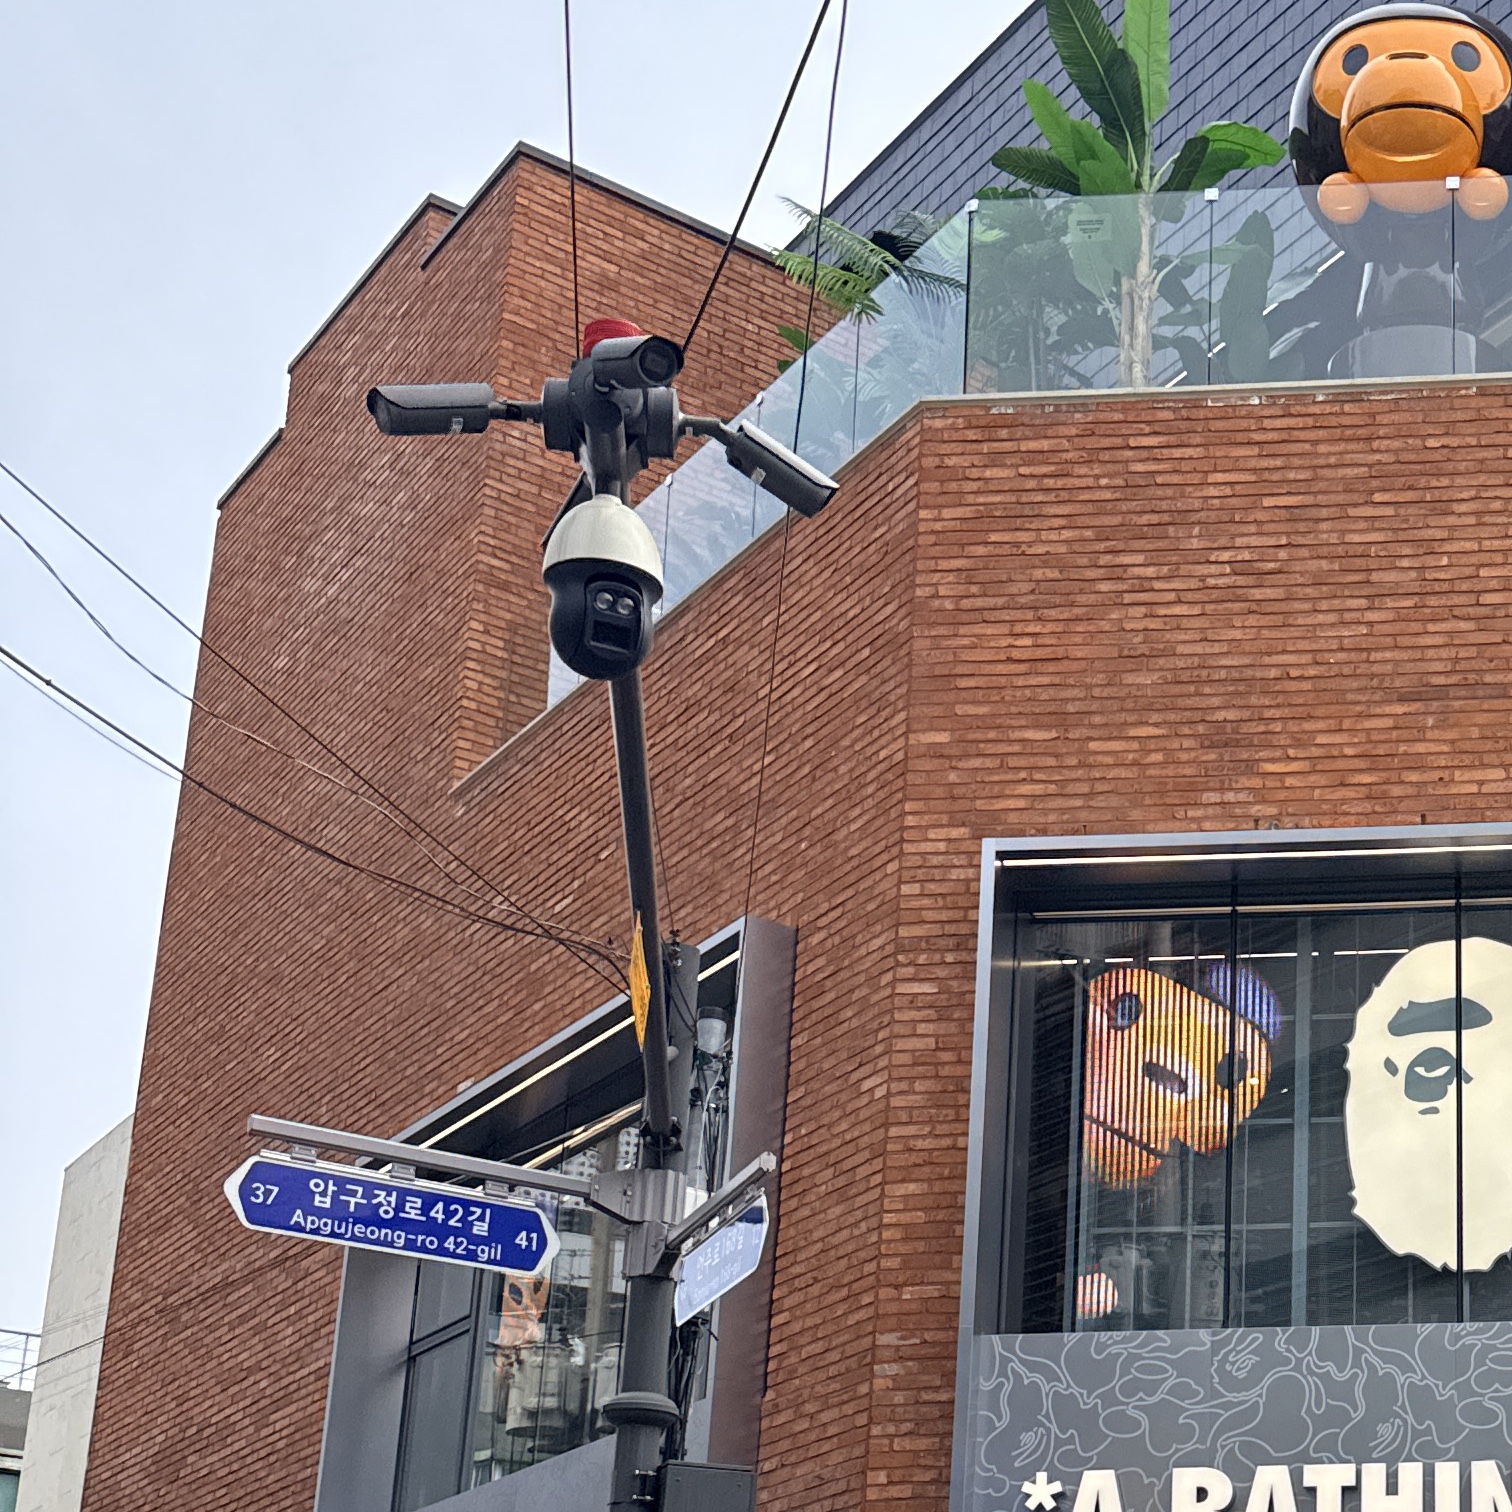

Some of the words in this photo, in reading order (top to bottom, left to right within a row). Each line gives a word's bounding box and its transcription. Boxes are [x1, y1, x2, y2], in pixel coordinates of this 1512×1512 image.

[250, 1181, 280, 1206] 37
[308, 1177, 491, 1237] 압구정로42길
[289, 1209, 439, 1250] Apgujeong-ro
[442, 1235, 502, 1262] 42-gil
[513, 1229, 539, 1252] 41
